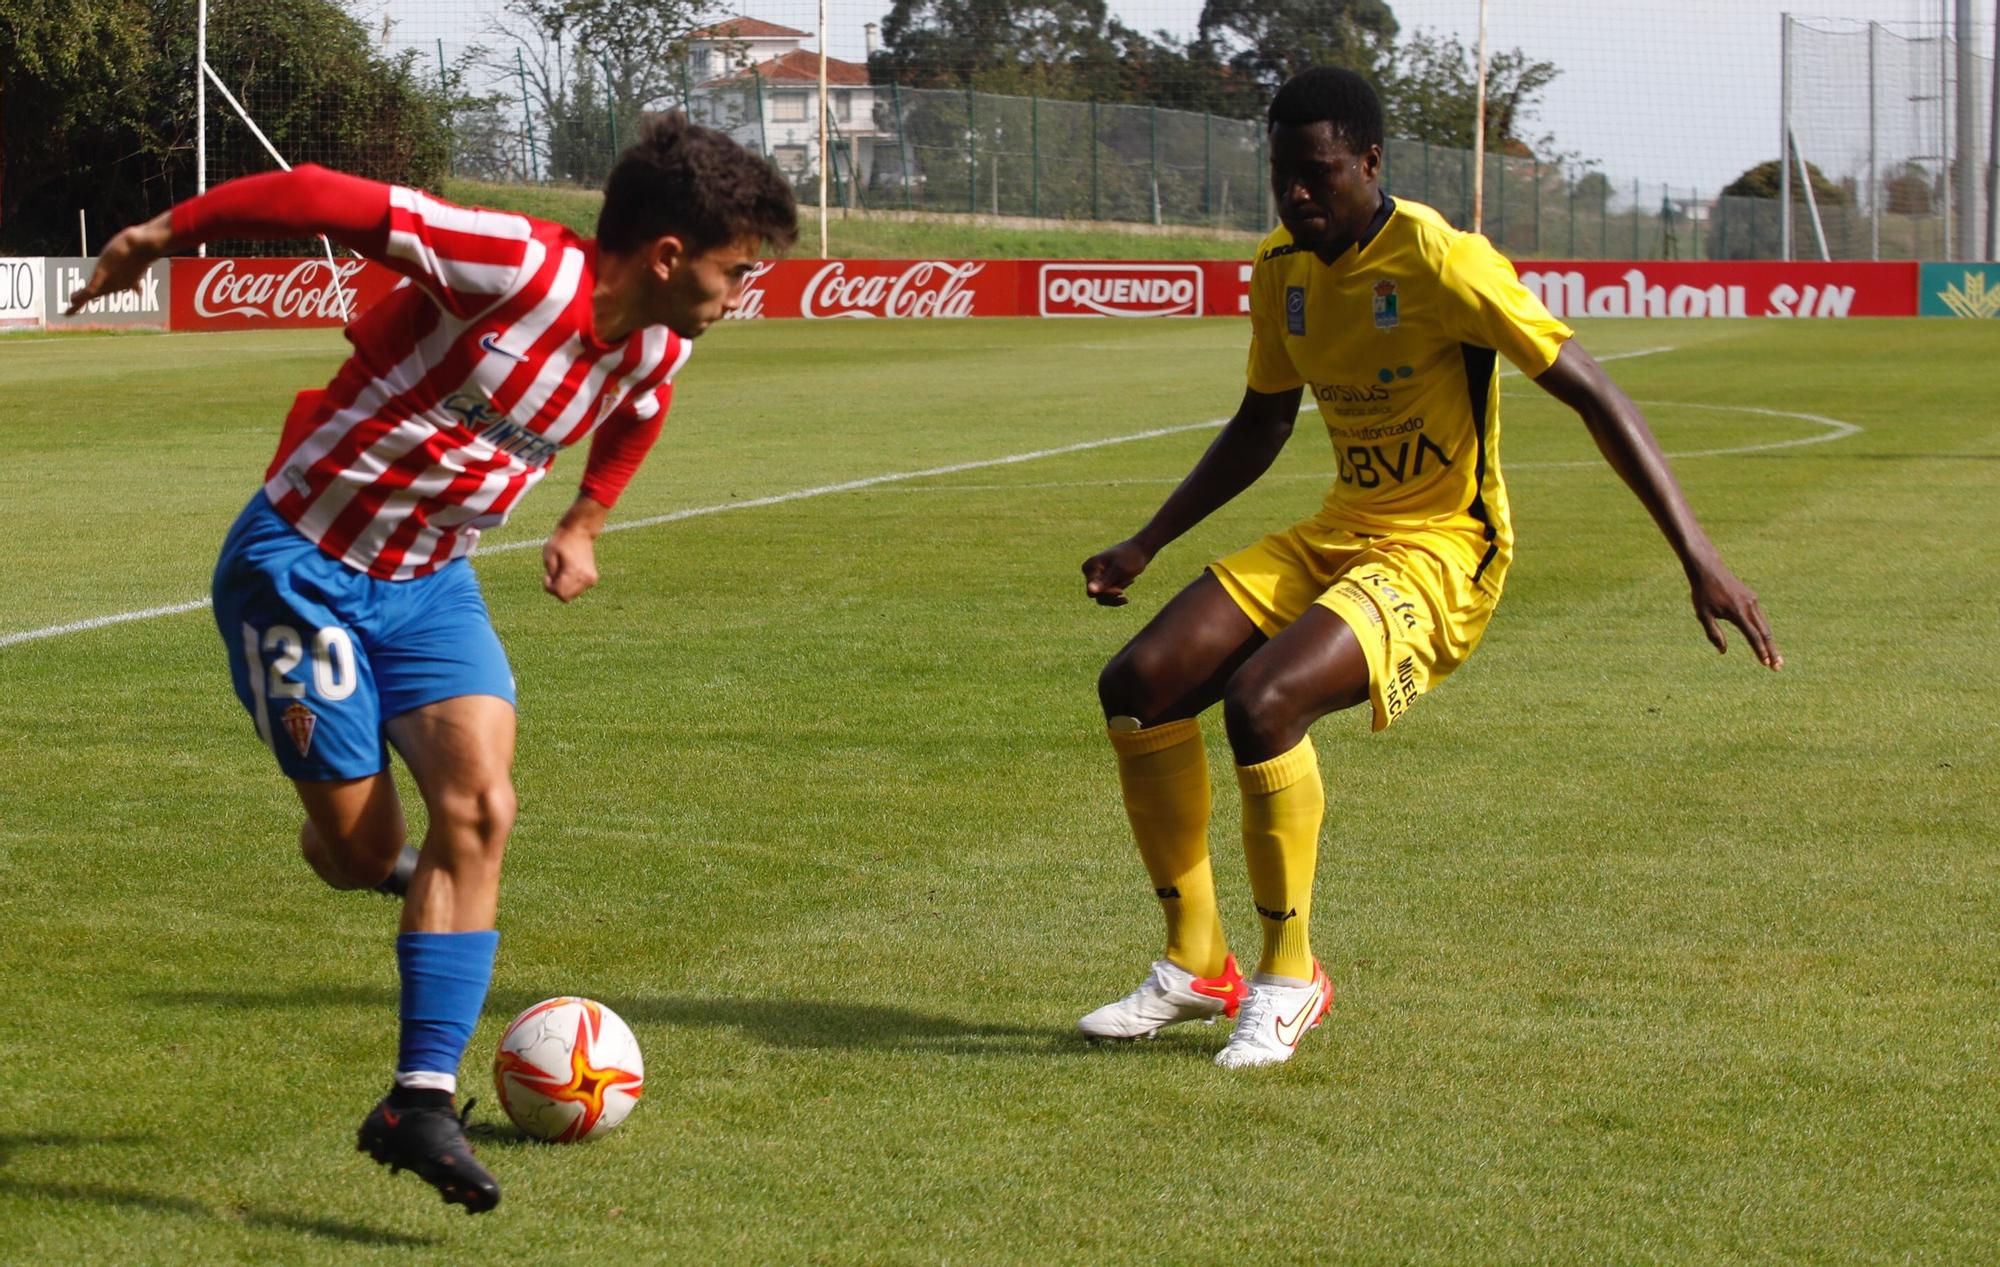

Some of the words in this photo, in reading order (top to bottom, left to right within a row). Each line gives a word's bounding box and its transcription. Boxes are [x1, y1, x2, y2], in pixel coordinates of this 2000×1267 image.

[194, 260, 367, 318] Coca-Cola
[801, 261, 986, 318] Coca-Cola
[1049, 278, 1194, 307] OQUENDO
[1519, 268, 1748, 318] Mahou
[1765, 284, 1856, 318] SIN
[263, 625, 357, 700] 20
